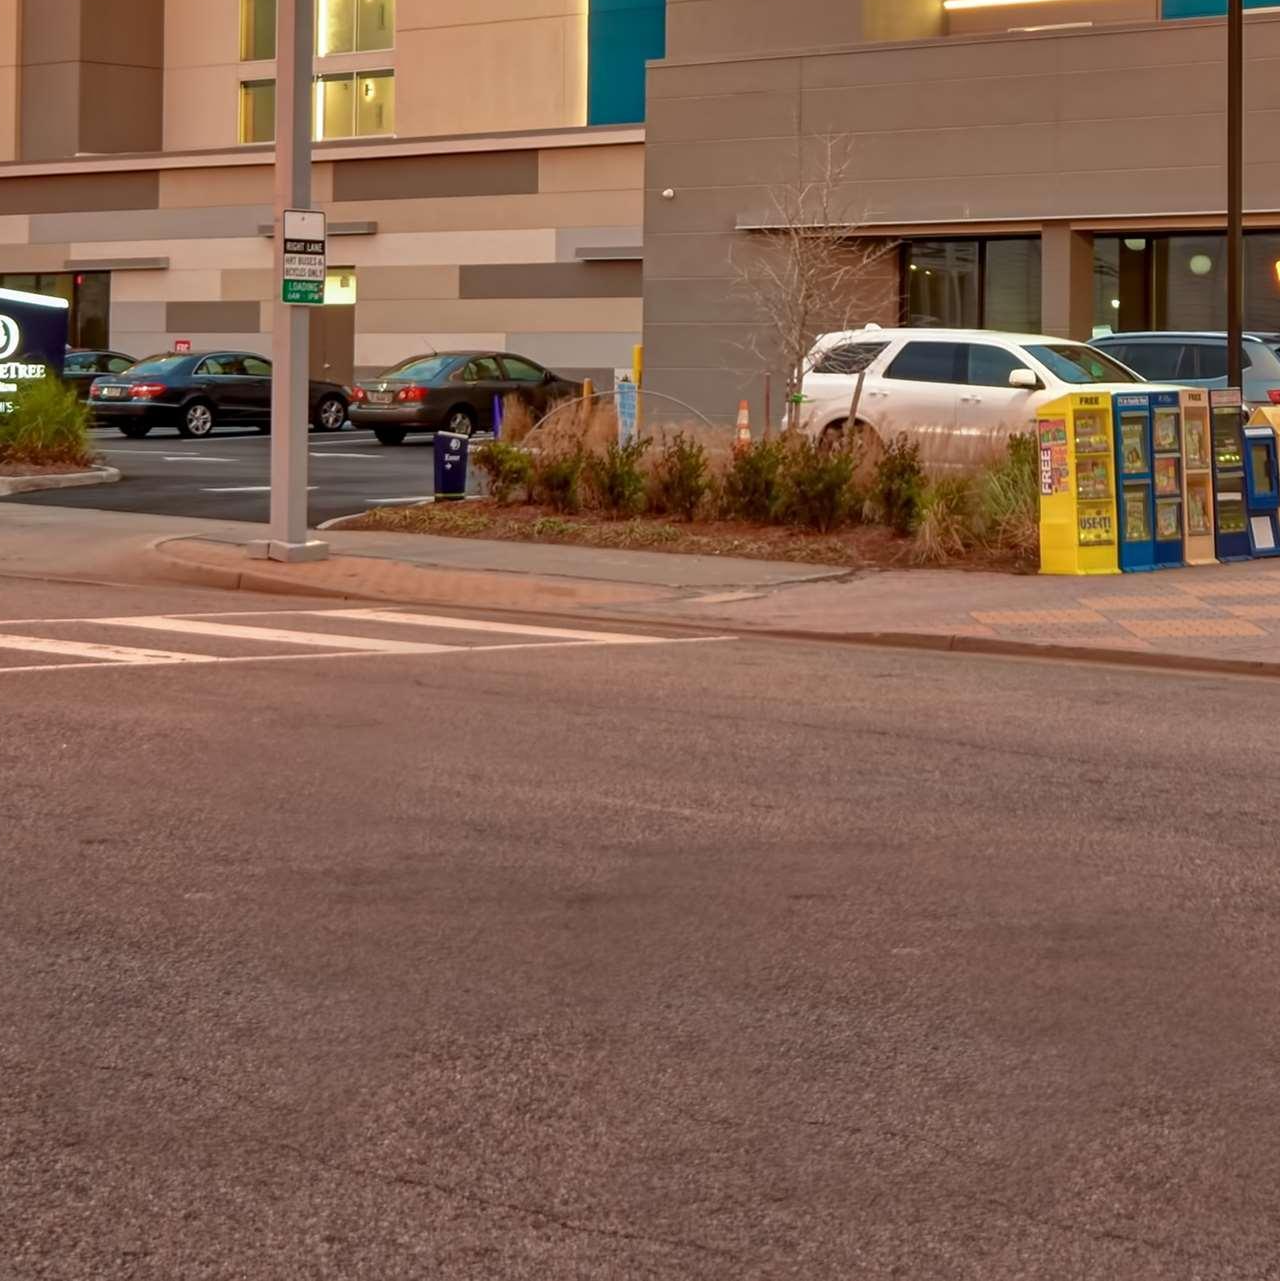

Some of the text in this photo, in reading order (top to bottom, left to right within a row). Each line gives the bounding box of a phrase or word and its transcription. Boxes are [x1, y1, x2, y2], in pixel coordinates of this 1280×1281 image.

[306, 242, 323, 253] LANE
[288, 282, 318, 292] LOADING
[1079, 396, 1100, 405] FREE
[1187, 392, 1202, 401] FREE
[1041, 448, 1052, 494] FREE
